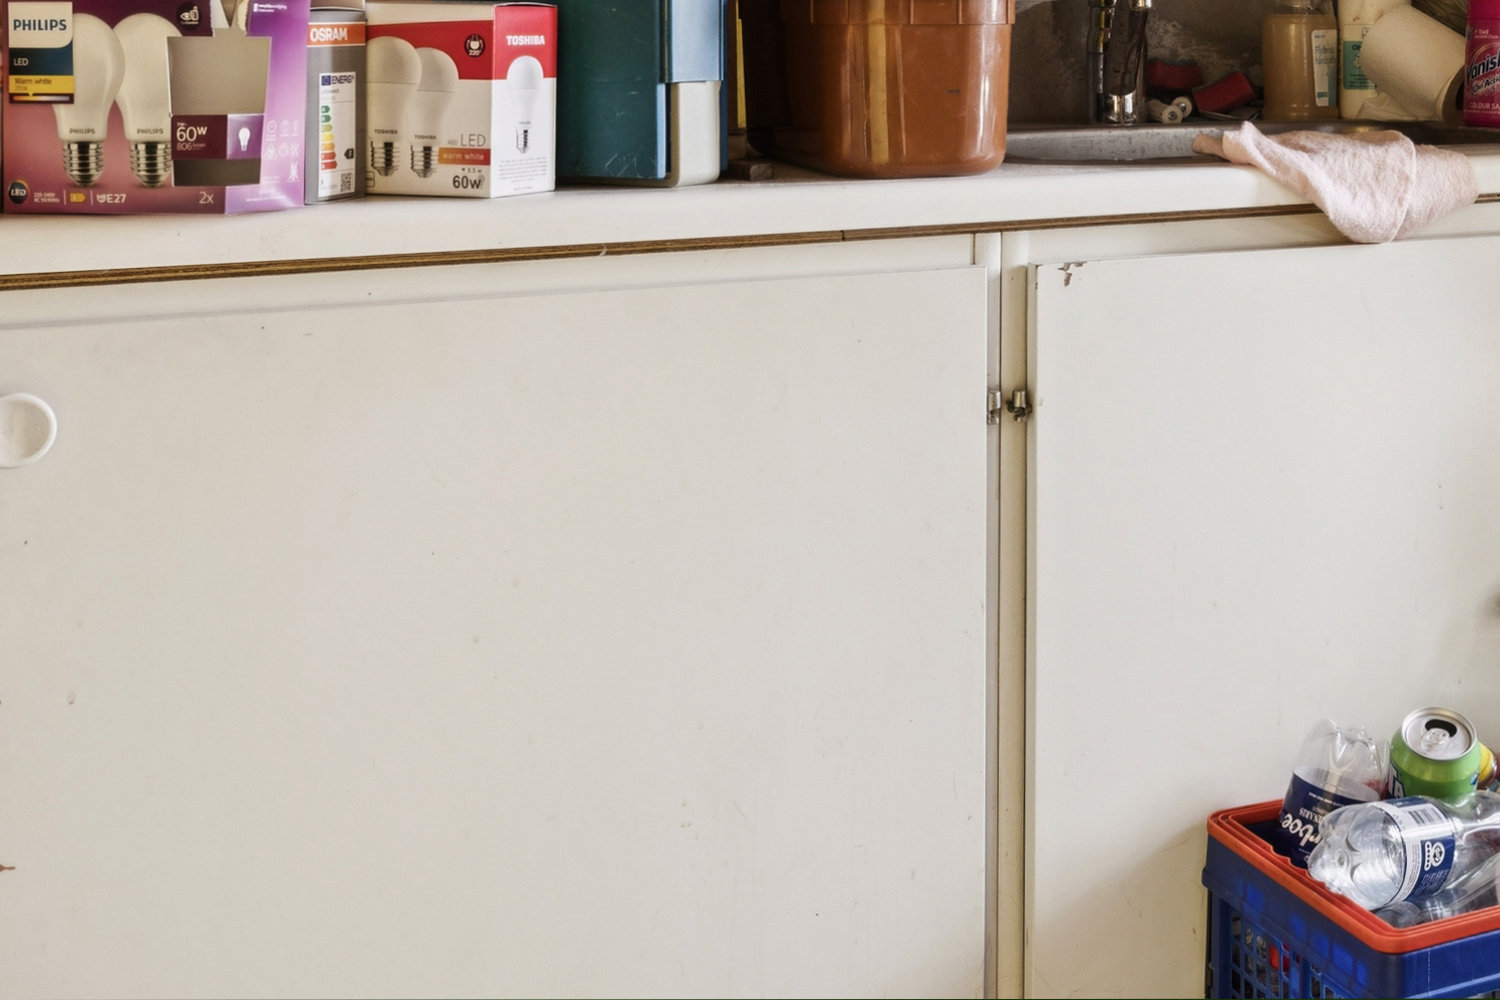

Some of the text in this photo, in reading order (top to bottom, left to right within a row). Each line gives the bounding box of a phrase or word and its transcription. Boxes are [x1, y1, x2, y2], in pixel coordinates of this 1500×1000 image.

[13, 19, 68, 31] PHILIPS
[310, 27, 348, 42] OSRAM
[506, 35, 546, 46] TOSHIBA
[13, 57, 29, 66] LED
[1470, 102, 1490, 110] COLOUR
[176, 126, 208, 142] 60W
[460, 133, 487, 147] LED
[176, 143, 193, 151] 806
[10, 188, 27, 196] LED
[199, 191, 214, 204] 2x
[107, 193, 127, 204] E27
[1282, 813, 1323, 847] rboe
